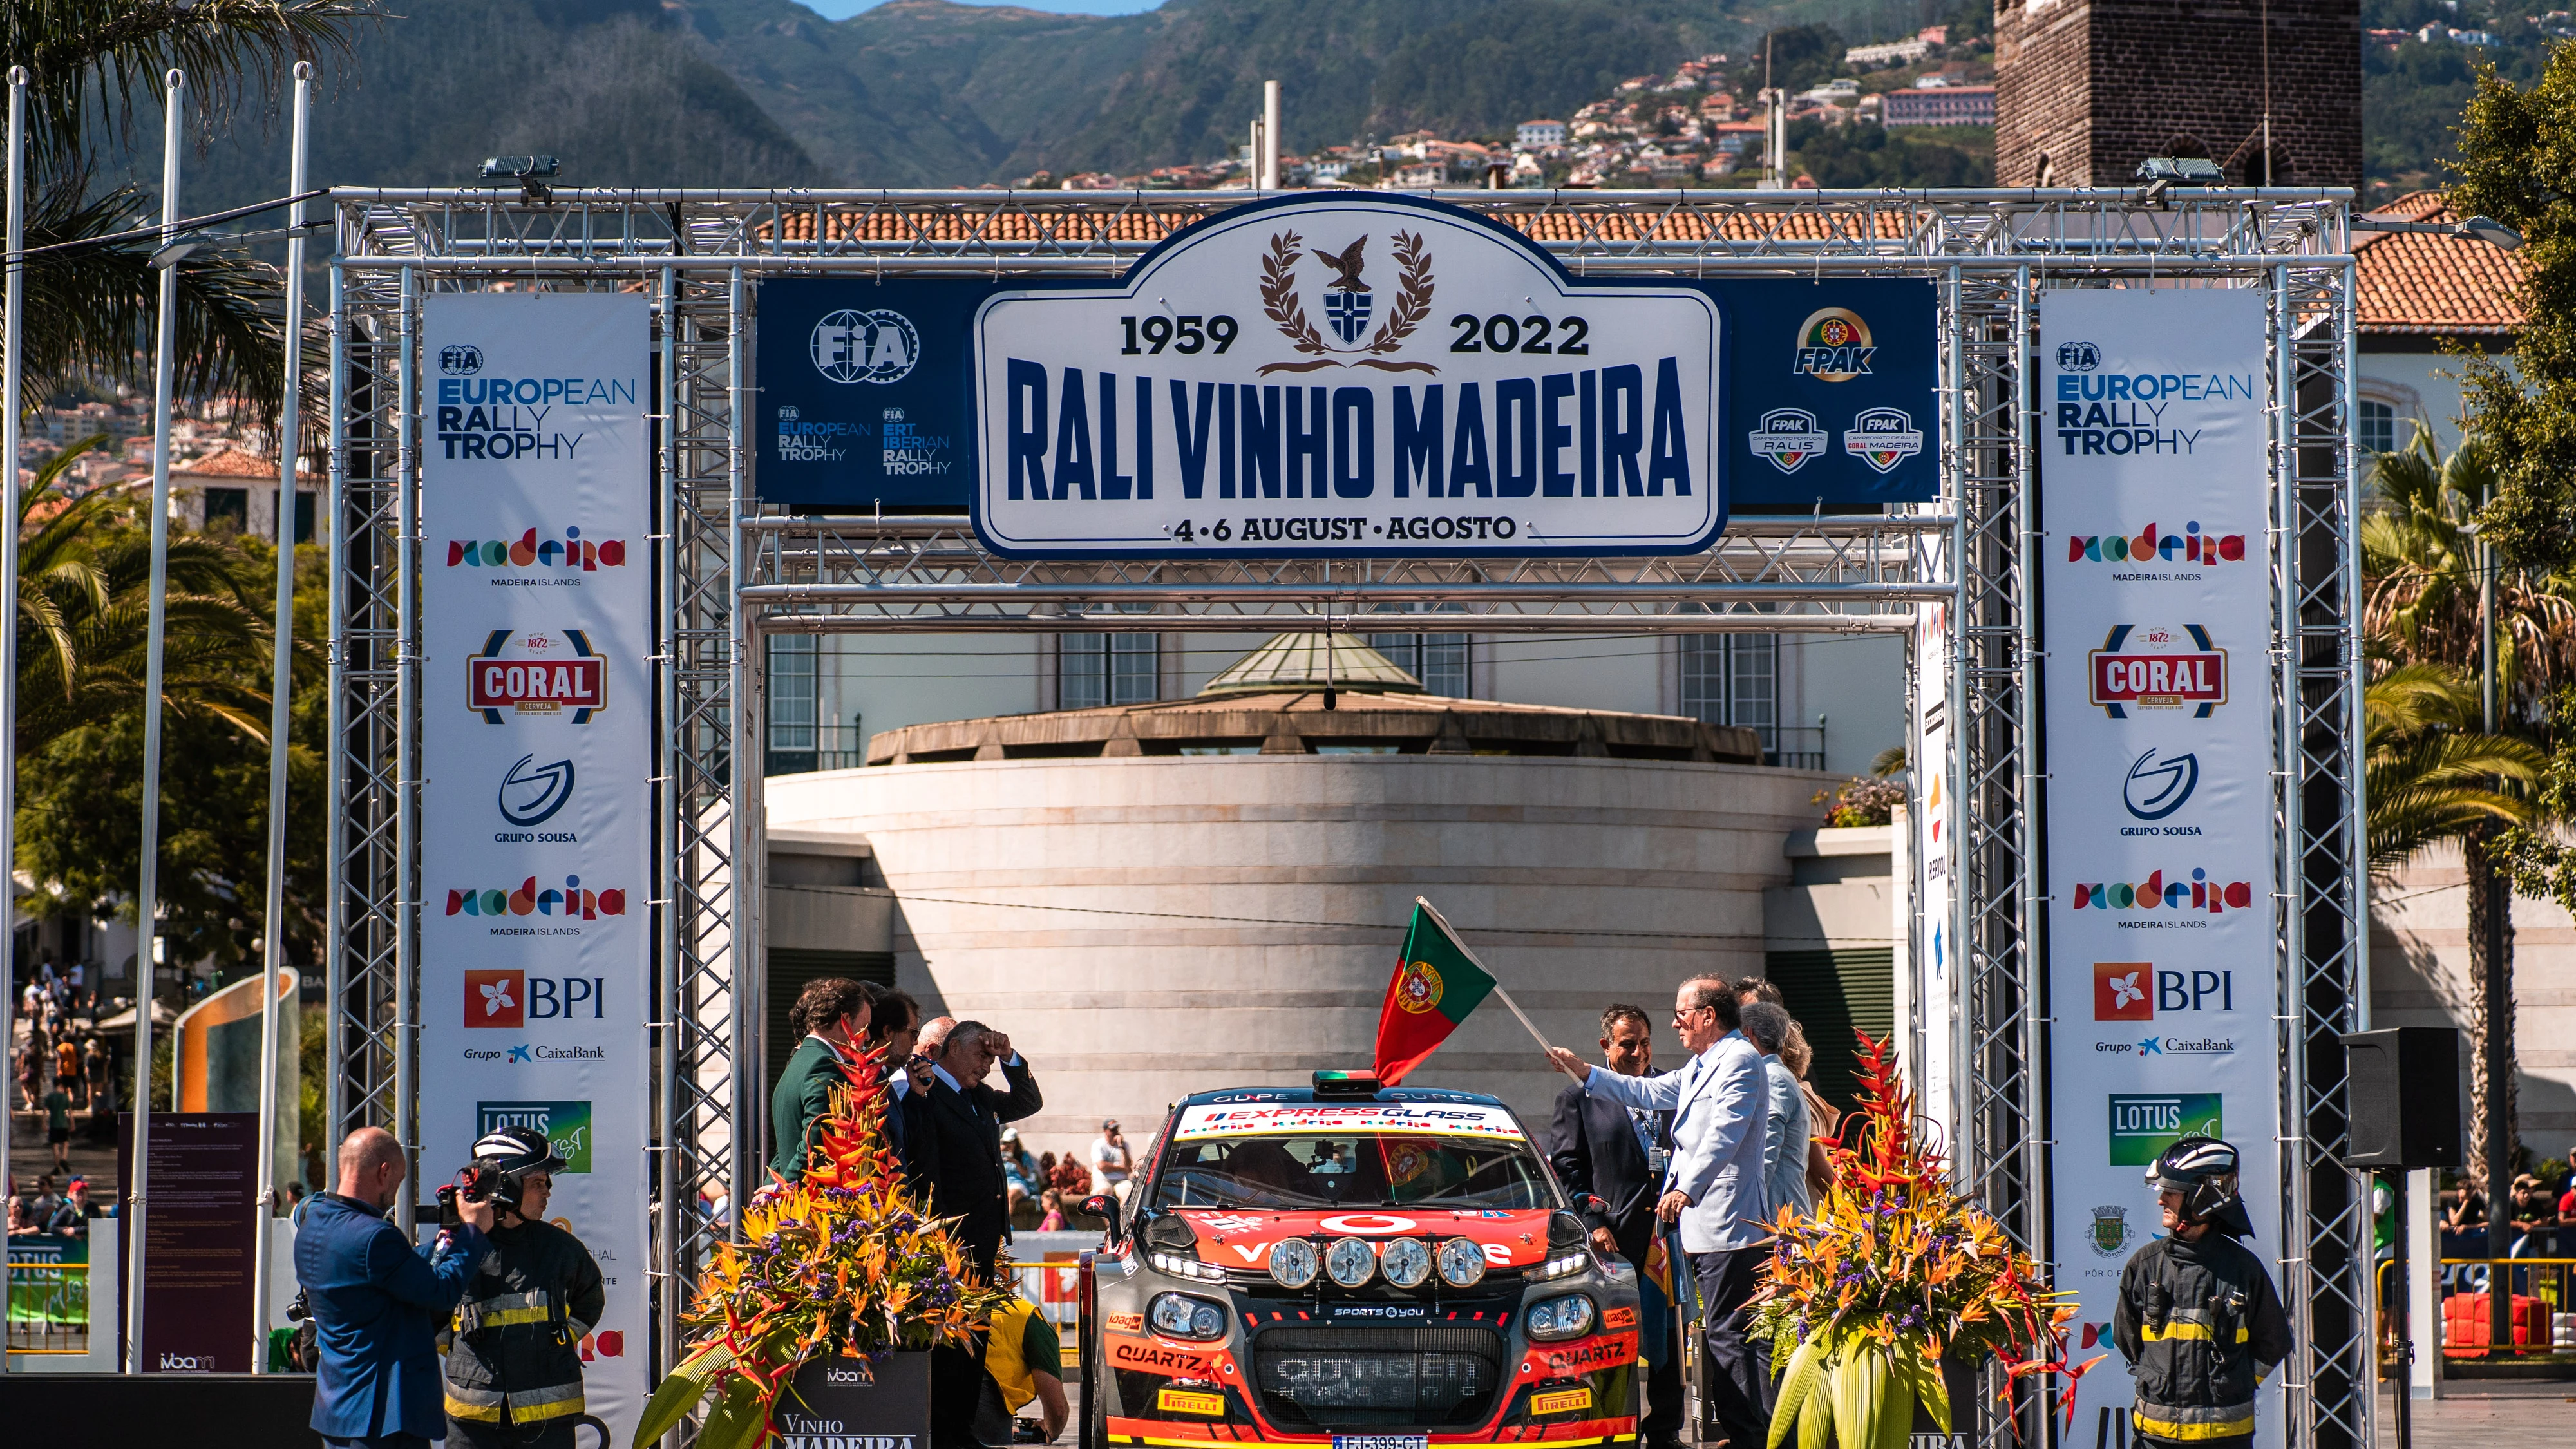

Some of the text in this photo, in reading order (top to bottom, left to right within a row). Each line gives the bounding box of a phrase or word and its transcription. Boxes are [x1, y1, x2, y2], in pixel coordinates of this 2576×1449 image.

[1120, 314, 1240, 356] 1959
[1449, 314, 1589, 356] 2022
[1793, 346, 1878, 374] FPAK
[438, 379, 634, 405] EUROPEAN
[2057, 374, 2251, 401] EUROPEAN
[438, 406, 551, 432] RALLY
[1771, 419, 1805, 431] FPAK
[1866, 419, 1900, 430] FPAK
[2057, 402, 2169, 428] RALLY
[779, 422, 870, 436] EUROPEAN
[883, 423, 915, 436] ERT
[1007, 356, 1692, 500] RALI VINHO MADEIRA
[438, 433, 583, 459] TROPHY
[779, 435, 831, 448] RALLY
[883, 436, 949, 449] IBERIAN
[1763, 442, 1814, 450] RALIS
[2058, 429, 2201, 455] TROPHY
[779, 448, 846, 461] TROPHY
[883, 449, 936, 462] RALLY
[883, 462, 951, 475] TROPHY
[1241, 518, 1367, 541] AUGUST
[1387, 517, 1516, 540] AGOSTO
[447, 526, 625, 571] madeira
[2069, 520, 2245, 566] madeira
[527, 638, 547, 648] 1872
[2149, 632, 2169, 643] 1872
[484, 666, 592, 698] CORAL
[2107, 661, 2213, 692] CORAL
[494, 833, 578, 843] GRUPO SOUSA
[2120, 826, 2202, 836] GRUPO SOUSA
[1929, 855, 1946, 882] REPSOL
[446, 874, 625, 920] madeira
[2074, 867, 2251, 913] madeira
[537, 927, 580, 936] ISLANDS
[527, 978, 605, 1019] BPI
[2157, 971, 2233, 1011] BPI
[464, 1046, 605, 1061] Grupo CaixaBank
[2096, 1038, 2234, 1052] Grupo CaixaBank
[1227, 1108, 1486, 1121] EXPRESSGLASS
[2116, 1106, 2181, 1130] LOTUS
[2091, 1242, 2103, 1256] CIDADE
[2112, 1242, 2130, 1256] FUNCHAL
[8, 1253, 62, 1278] OTUS
[1117, 1345, 1202, 1370] QUARTZ
[1548, 1342, 1625, 1370] QUARTZ
[1164, 1393, 1217, 1411] PIRELLI
[1537, 1391, 1587, 1412] PIRELLI
